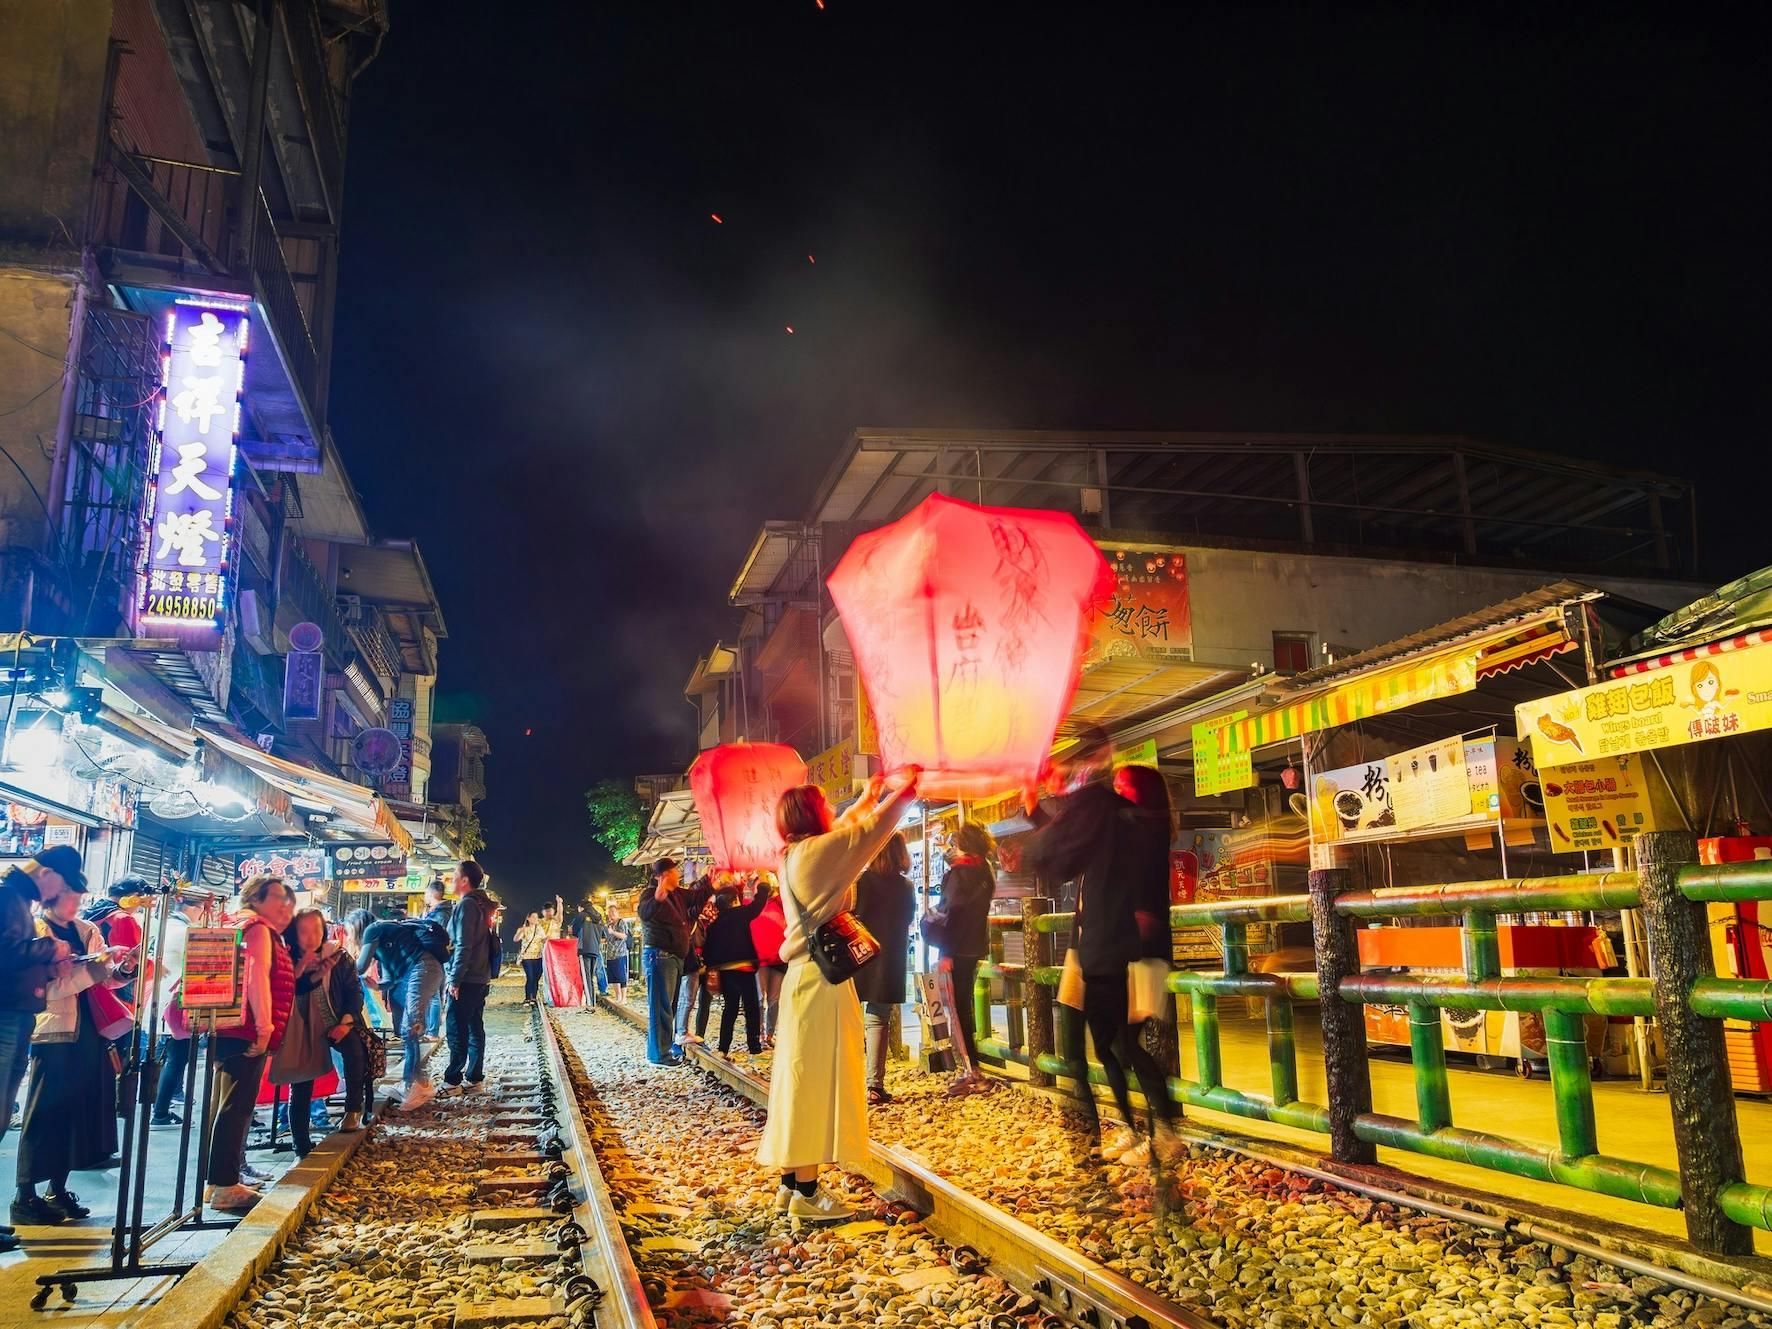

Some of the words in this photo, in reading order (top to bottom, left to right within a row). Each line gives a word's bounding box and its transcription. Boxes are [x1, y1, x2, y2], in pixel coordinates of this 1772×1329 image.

[156, 312, 227, 567] 吉祥天燈
[150, 569, 219, 595] 批發零售
[147, 594, 216, 620] 24958850
[1601, 720, 1631, 735] Wings
[1632, 712, 1664, 728] board
[1475, 765, 1488, 776] tea
[928, 979, 935, 990] 6
[931, 1000, 943, 1018] 2
